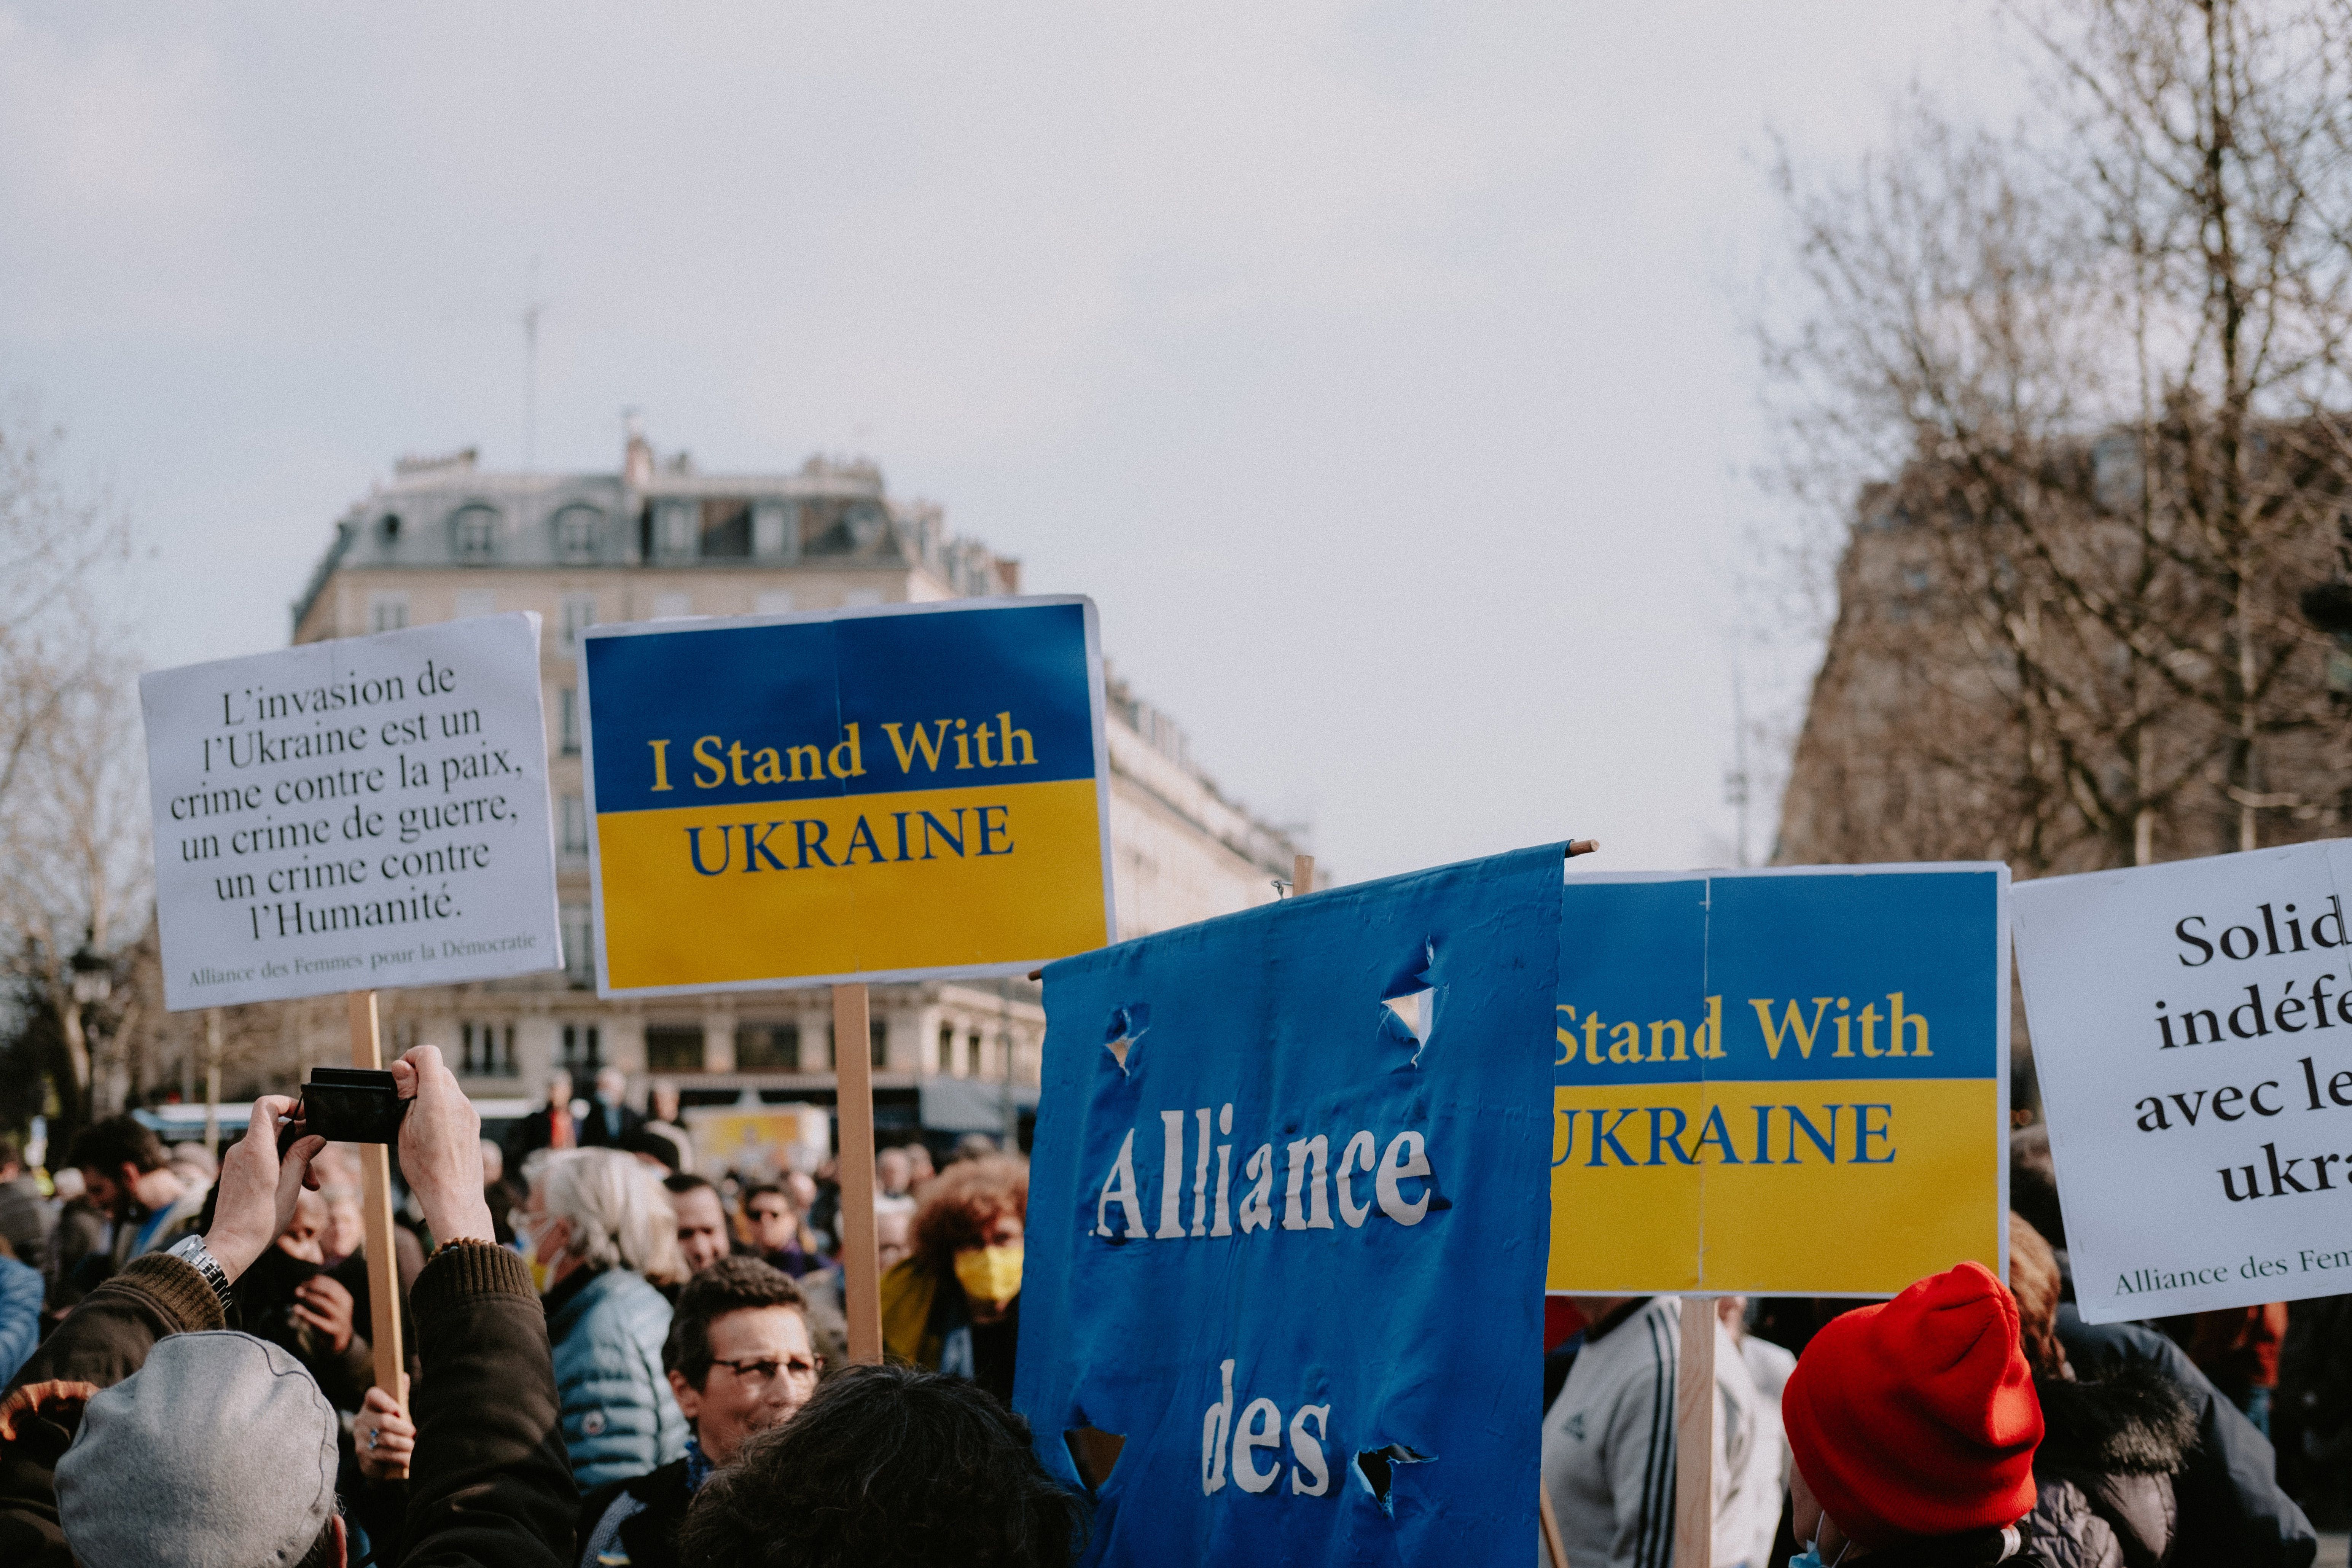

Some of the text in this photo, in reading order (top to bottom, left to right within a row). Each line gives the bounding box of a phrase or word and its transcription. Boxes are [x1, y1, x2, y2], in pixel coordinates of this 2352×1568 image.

[222, 659, 455, 727] L’invasion de
[203, 708, 481, 773] l’Ukraine est un
[648, 711, 1038, 791] I Stand With
[170, 741, 523, 821] crime contre la paix,
[181, 795, 518, 863] un crime de guerre,
[685, 805, 1014, 876] UKRAINE
[215, 843, 490, 902] un crime contre
[189, 934, 536, 986] Alliance des Femmes pour la Démocratie
[2175, 895, 2352, 967] Solid
[1747, 991, 1934, 1060] With
[2134, 1080, 2284, 1132] avec
[1088, 1103, 1432, 1239] Alliance
[2217, 1142, 2352, 1203] ukr
[2115, 1265, 2228, 1296] Alliance
[2240, 1256, 2288, 1279] des
[1202, 1359, 1331, 1496] des
